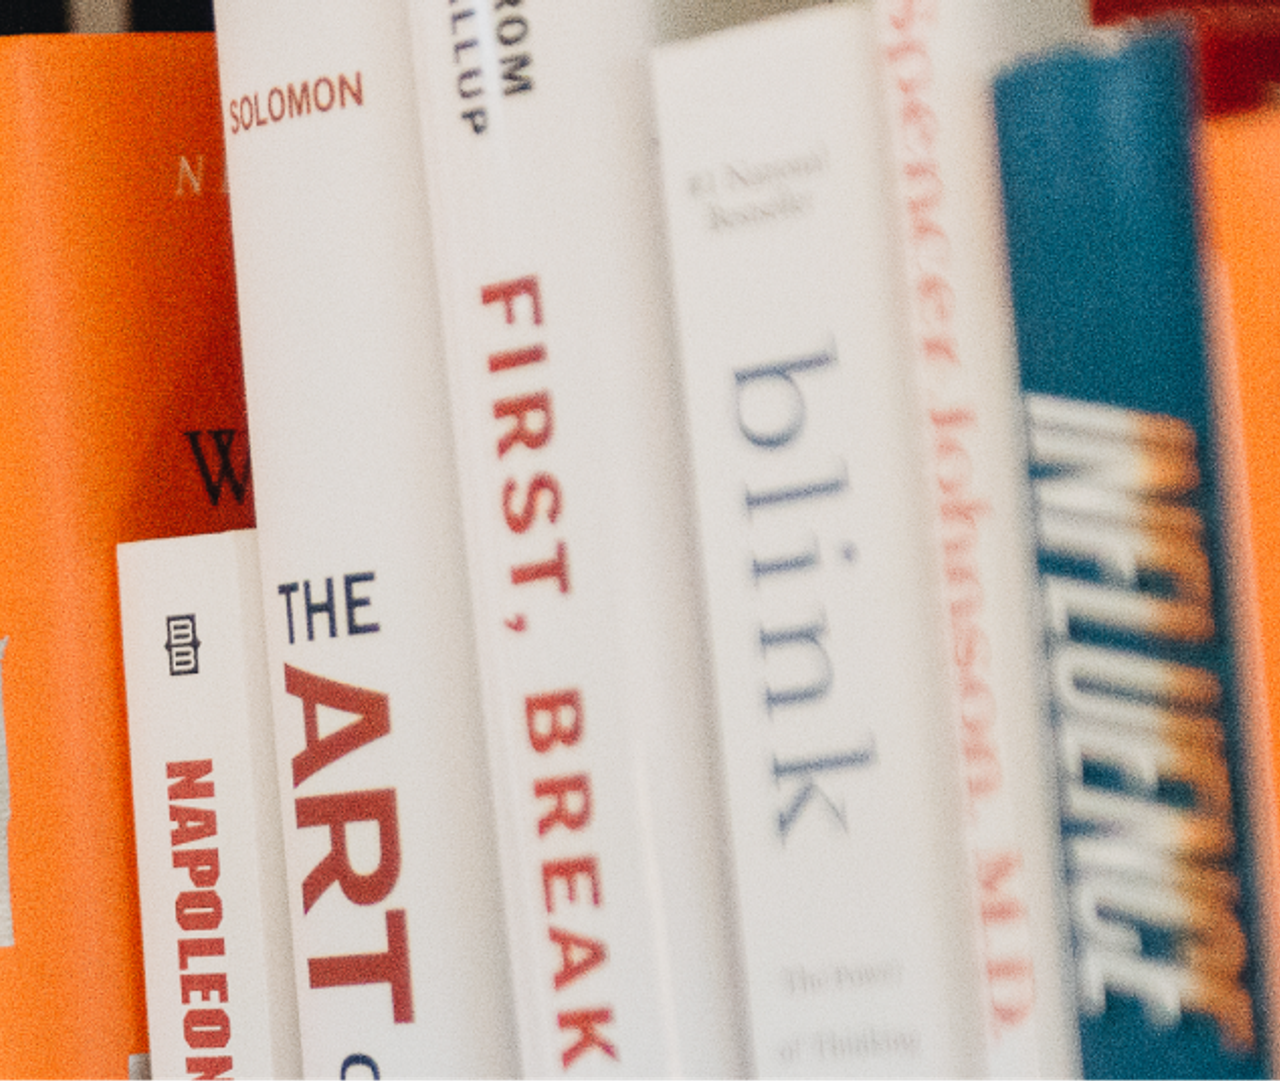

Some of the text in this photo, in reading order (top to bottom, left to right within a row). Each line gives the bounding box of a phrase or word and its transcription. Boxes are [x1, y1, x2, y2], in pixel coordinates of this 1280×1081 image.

[229, 71, 364, 134] SOLOMON
[448, 0, 488, 134] LLUP
[277, 571, 381, 645] THE
[481, 273, 621, 1069] FIRST, BREAK
[733, 332, 876, 847] blink
[1022, 390, 1258, 1054] INFLUENCE
[165, 758, 234, 1081] NAPOLEON
[282, 662, 415, 1025] ART
